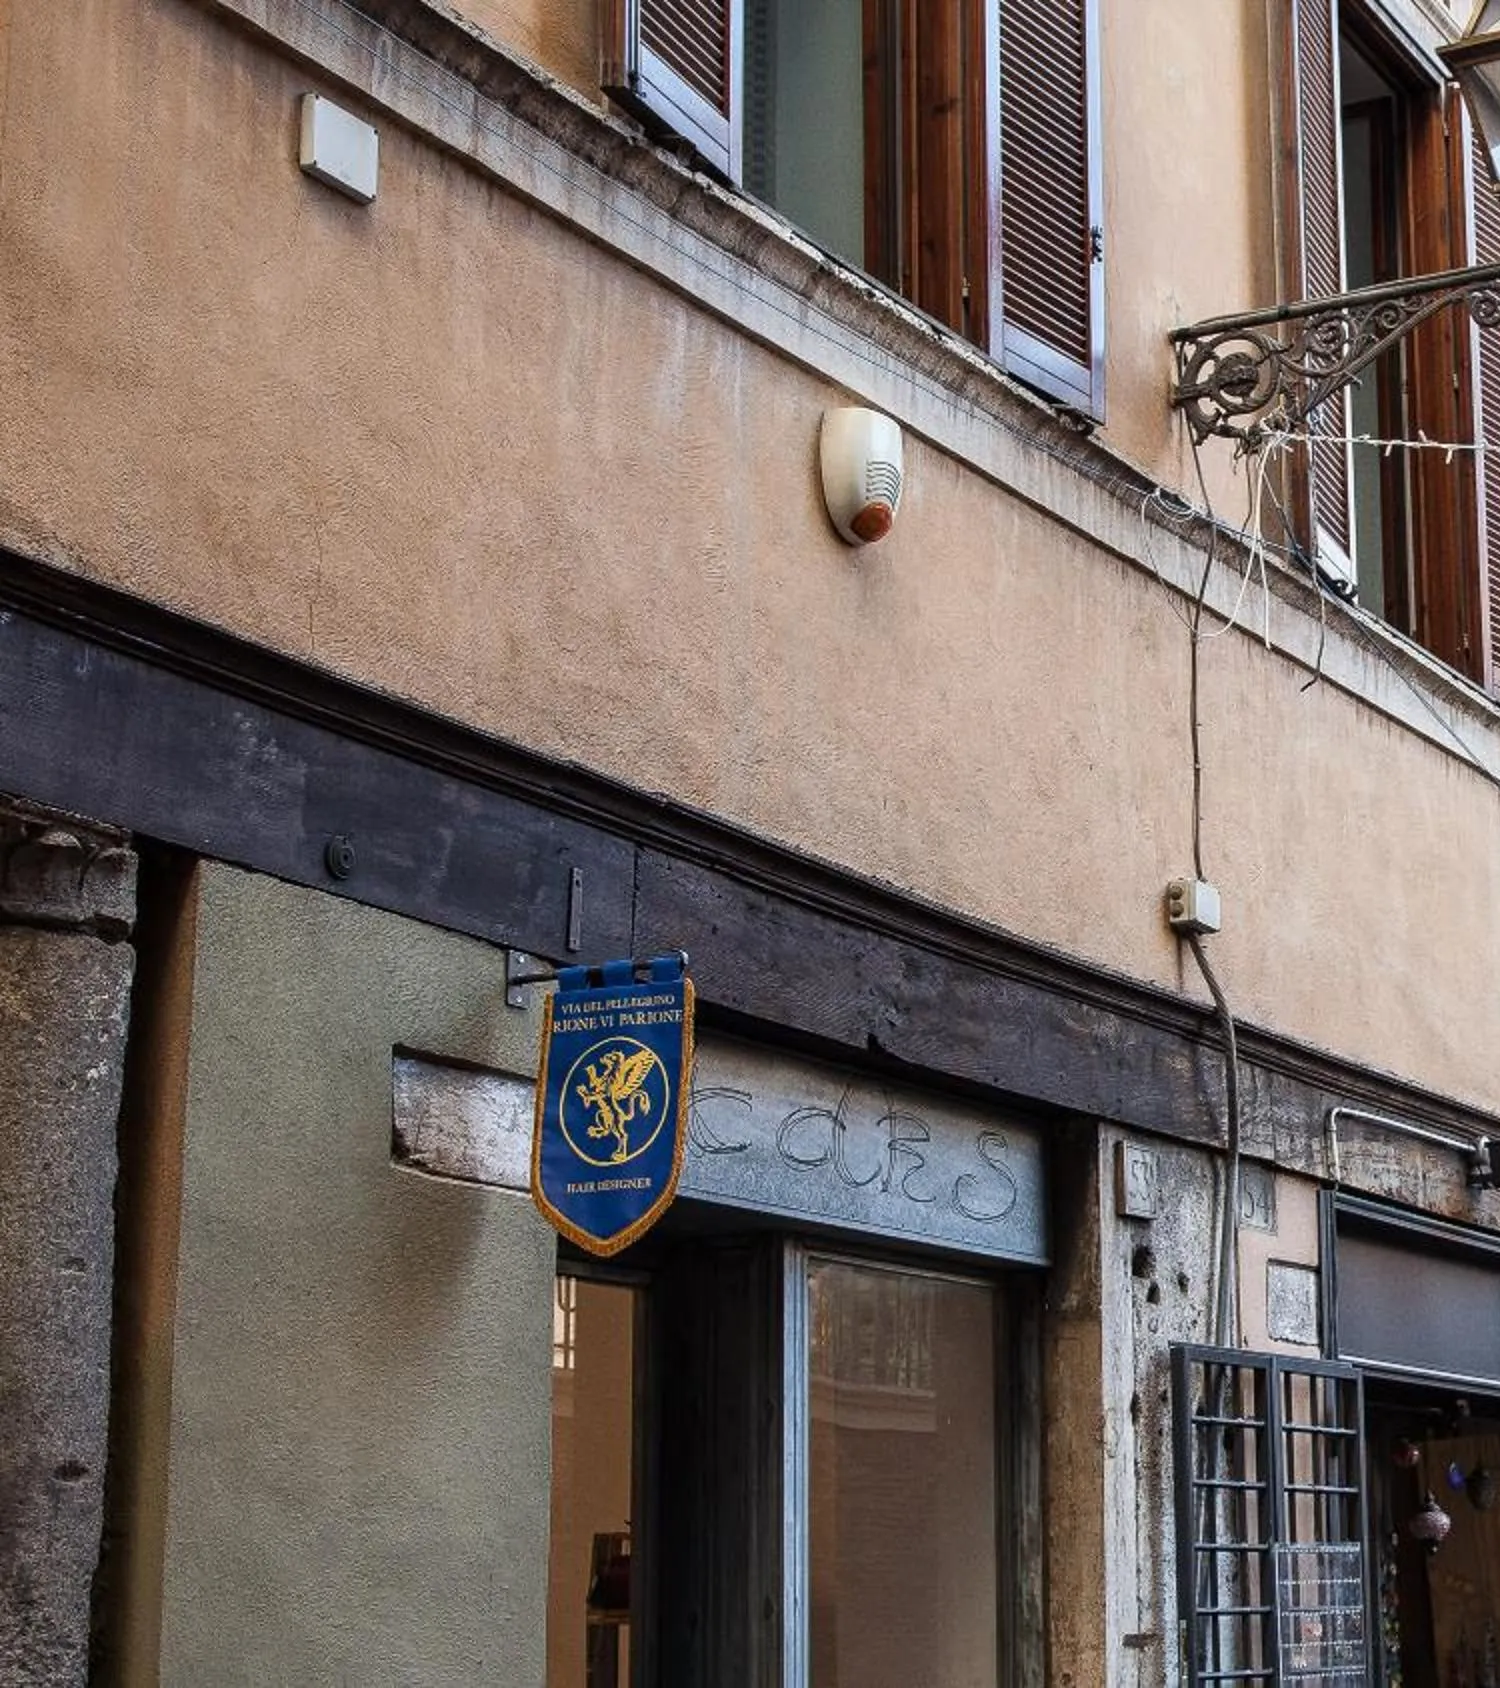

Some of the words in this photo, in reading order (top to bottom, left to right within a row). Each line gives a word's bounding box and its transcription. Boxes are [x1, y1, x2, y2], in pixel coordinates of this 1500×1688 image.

[561, 1002, 581, 1015] VIA
[583, 1000, 604, 1013] DEL
[605, 994, 675, 1010] PELLEGRINO
[553, 1017, 598, 1033] RIONE
[600, 1014, 614, 1028] VI
[619, 1009, 683, 1027] PARIONE
[567, 1181, 597, 1194] HAIR
[597, 1177, 652, 1192] DESIGNER
